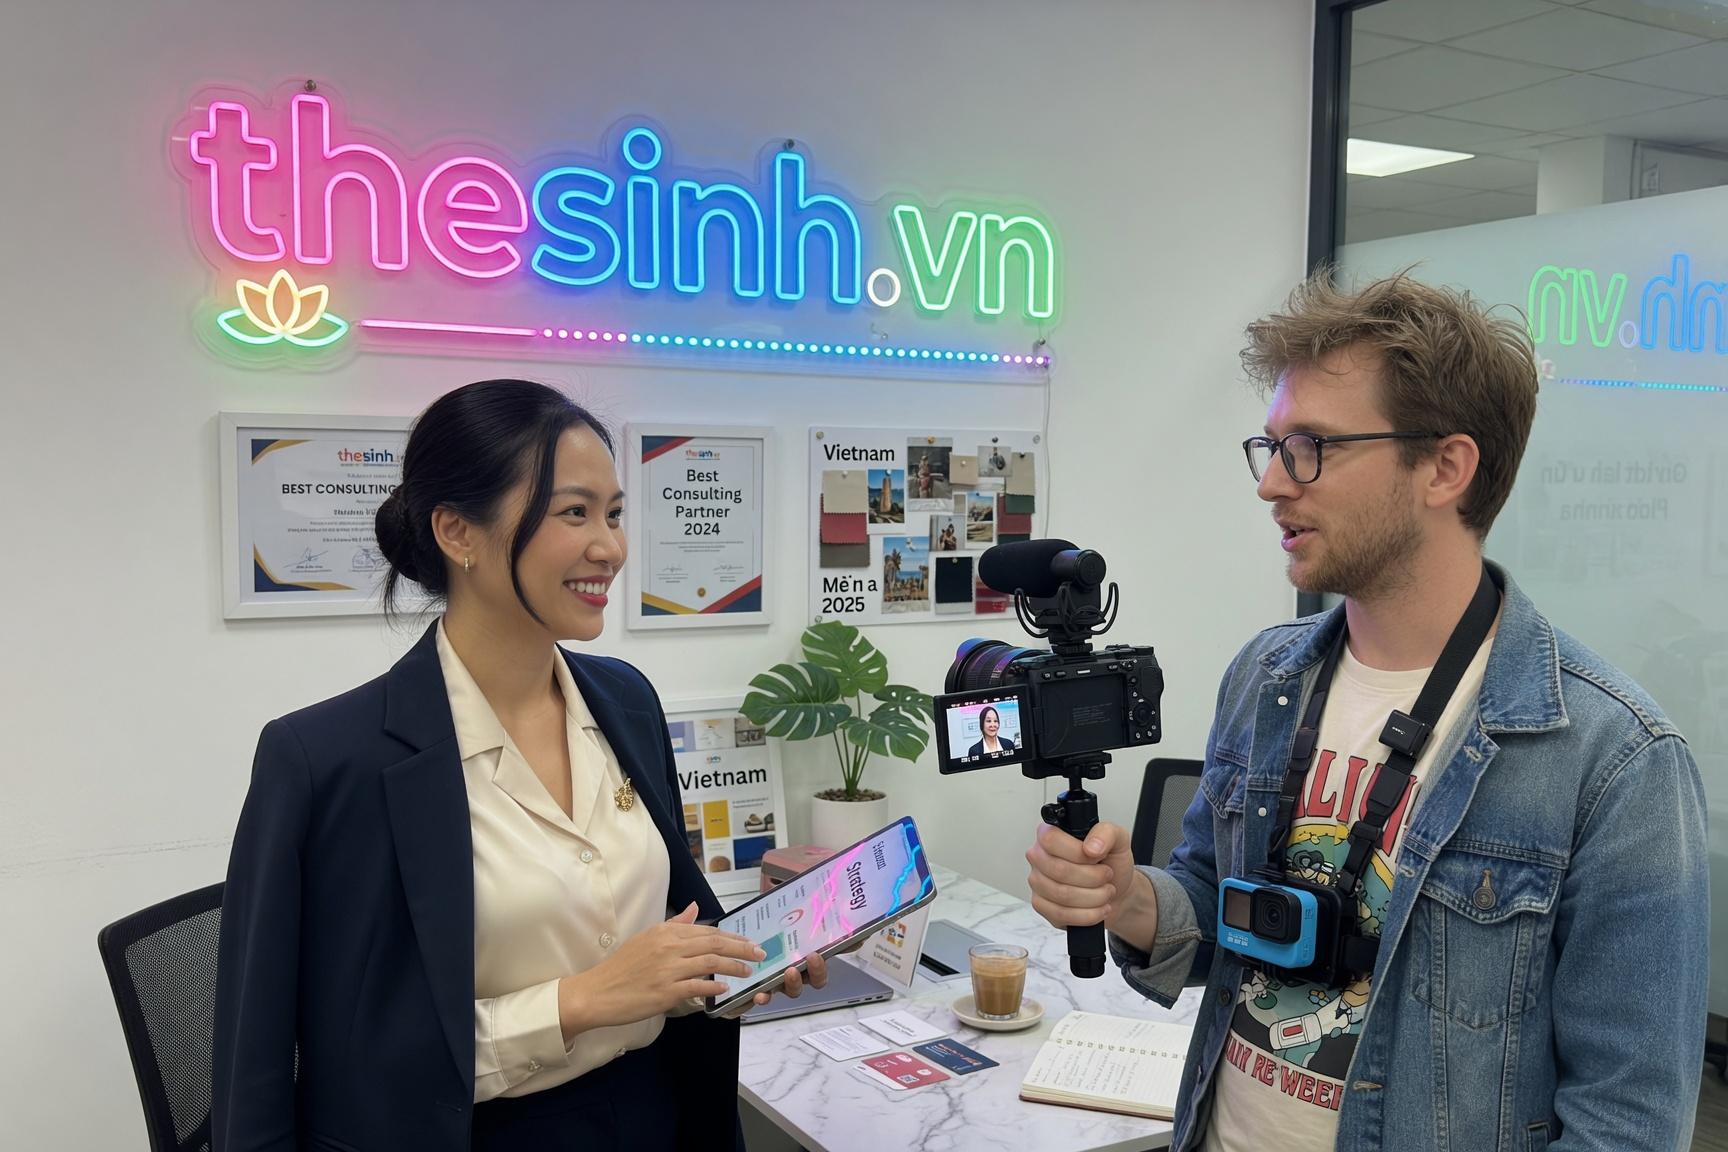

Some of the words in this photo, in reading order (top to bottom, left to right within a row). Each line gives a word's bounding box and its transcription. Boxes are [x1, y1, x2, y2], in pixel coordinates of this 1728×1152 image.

[189, 92, 1057, 319] thesinh.vn
[823, 443, 895, 463] Vietnam
[686, 469, 719, 482] Best
[282, 484, 312, 495] BEST
[316, 483, 398, 495] CONSULTING
[662, 487, 742, 503] Consulting
[675, 505, 731, 518] Partner
[684, 522, 721, 535] 2024
[822, 597, 865, 613] 2025
[678, 768, 767, 790] Vietnam
[846, 860, 868, 911] Strategy
